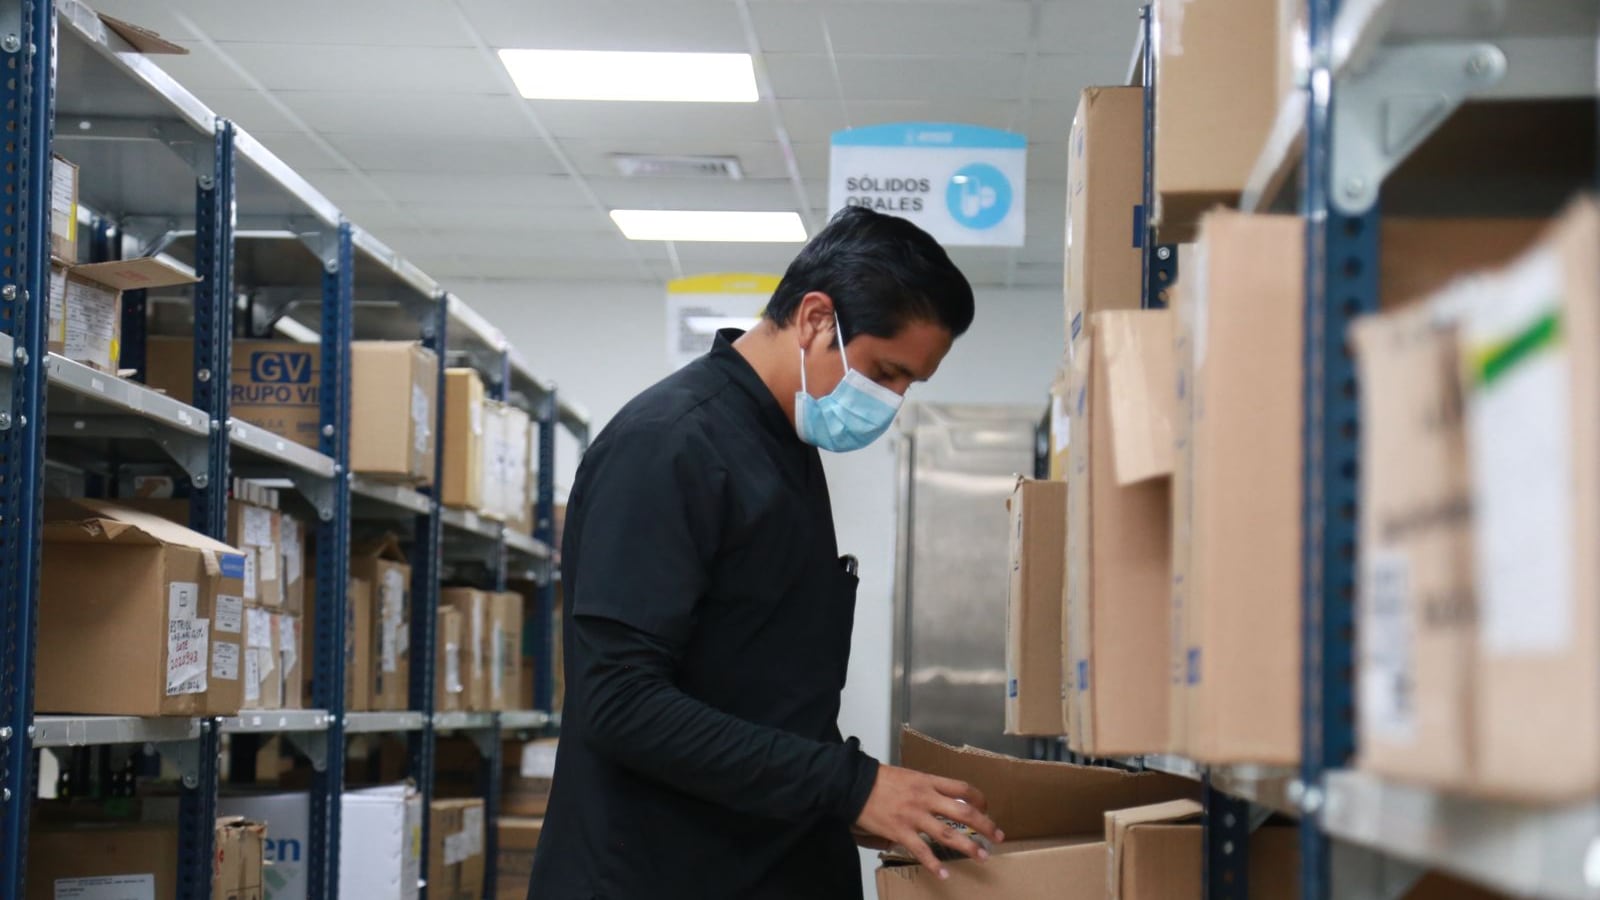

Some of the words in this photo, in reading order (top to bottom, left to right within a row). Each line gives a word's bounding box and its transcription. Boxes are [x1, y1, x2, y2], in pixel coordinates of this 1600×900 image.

[847, 174, 930, 192] SÓLIDOS
[256, 354, 308, 382] GV
[231, 385, 291, 403] RUPO
